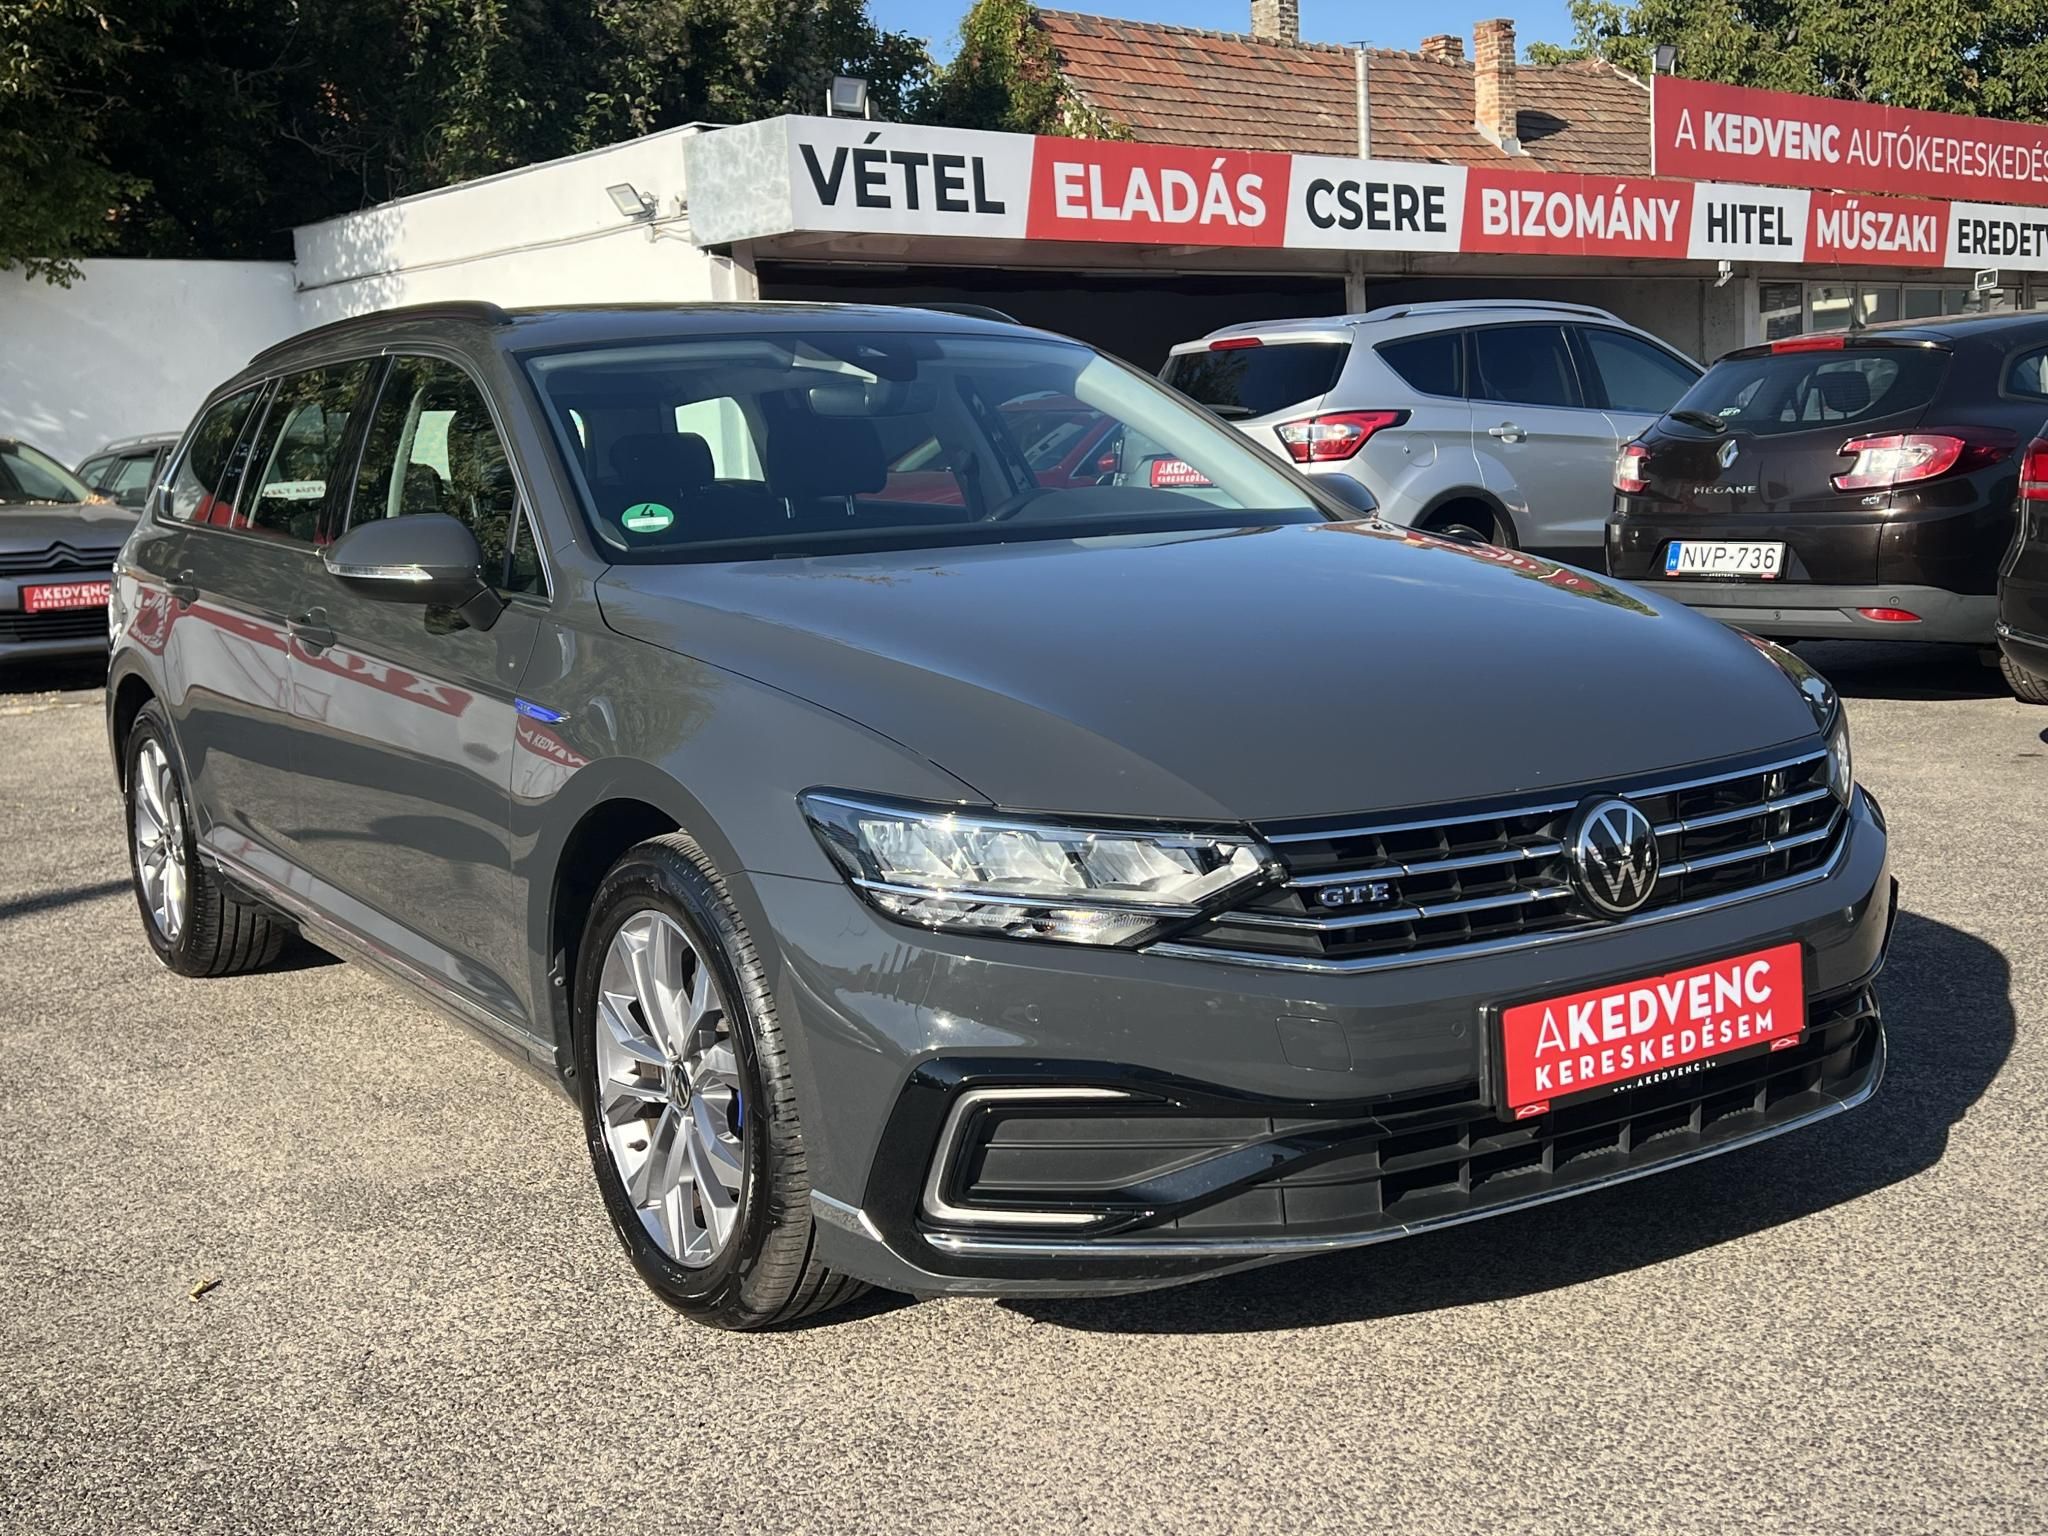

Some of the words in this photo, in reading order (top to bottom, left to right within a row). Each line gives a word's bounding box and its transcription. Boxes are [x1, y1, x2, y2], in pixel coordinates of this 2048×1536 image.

[1674, 108, 1697, 150] A
[1704, 110, 1841, 164] KEDVENC
[799, 131, 1006, 214] VÉTEL
[1053, 157, 1266, 227] ELADÁS
[1305, 178, 1447, 233] CSERE
[1481, 183, 1680, 242] BIZOMÁNY
[1707, 202, 1793, 246] HITEL
[1816, 199, 1937, 253] MŰSZAKI
[640, 504, 655, 517] 4
[1682, 546, 1776, 570] NVP-736
[1320, 882, 1389, 907] GTE
[1535, 1008, 1773, 1091] KERESKEDÉSEM
